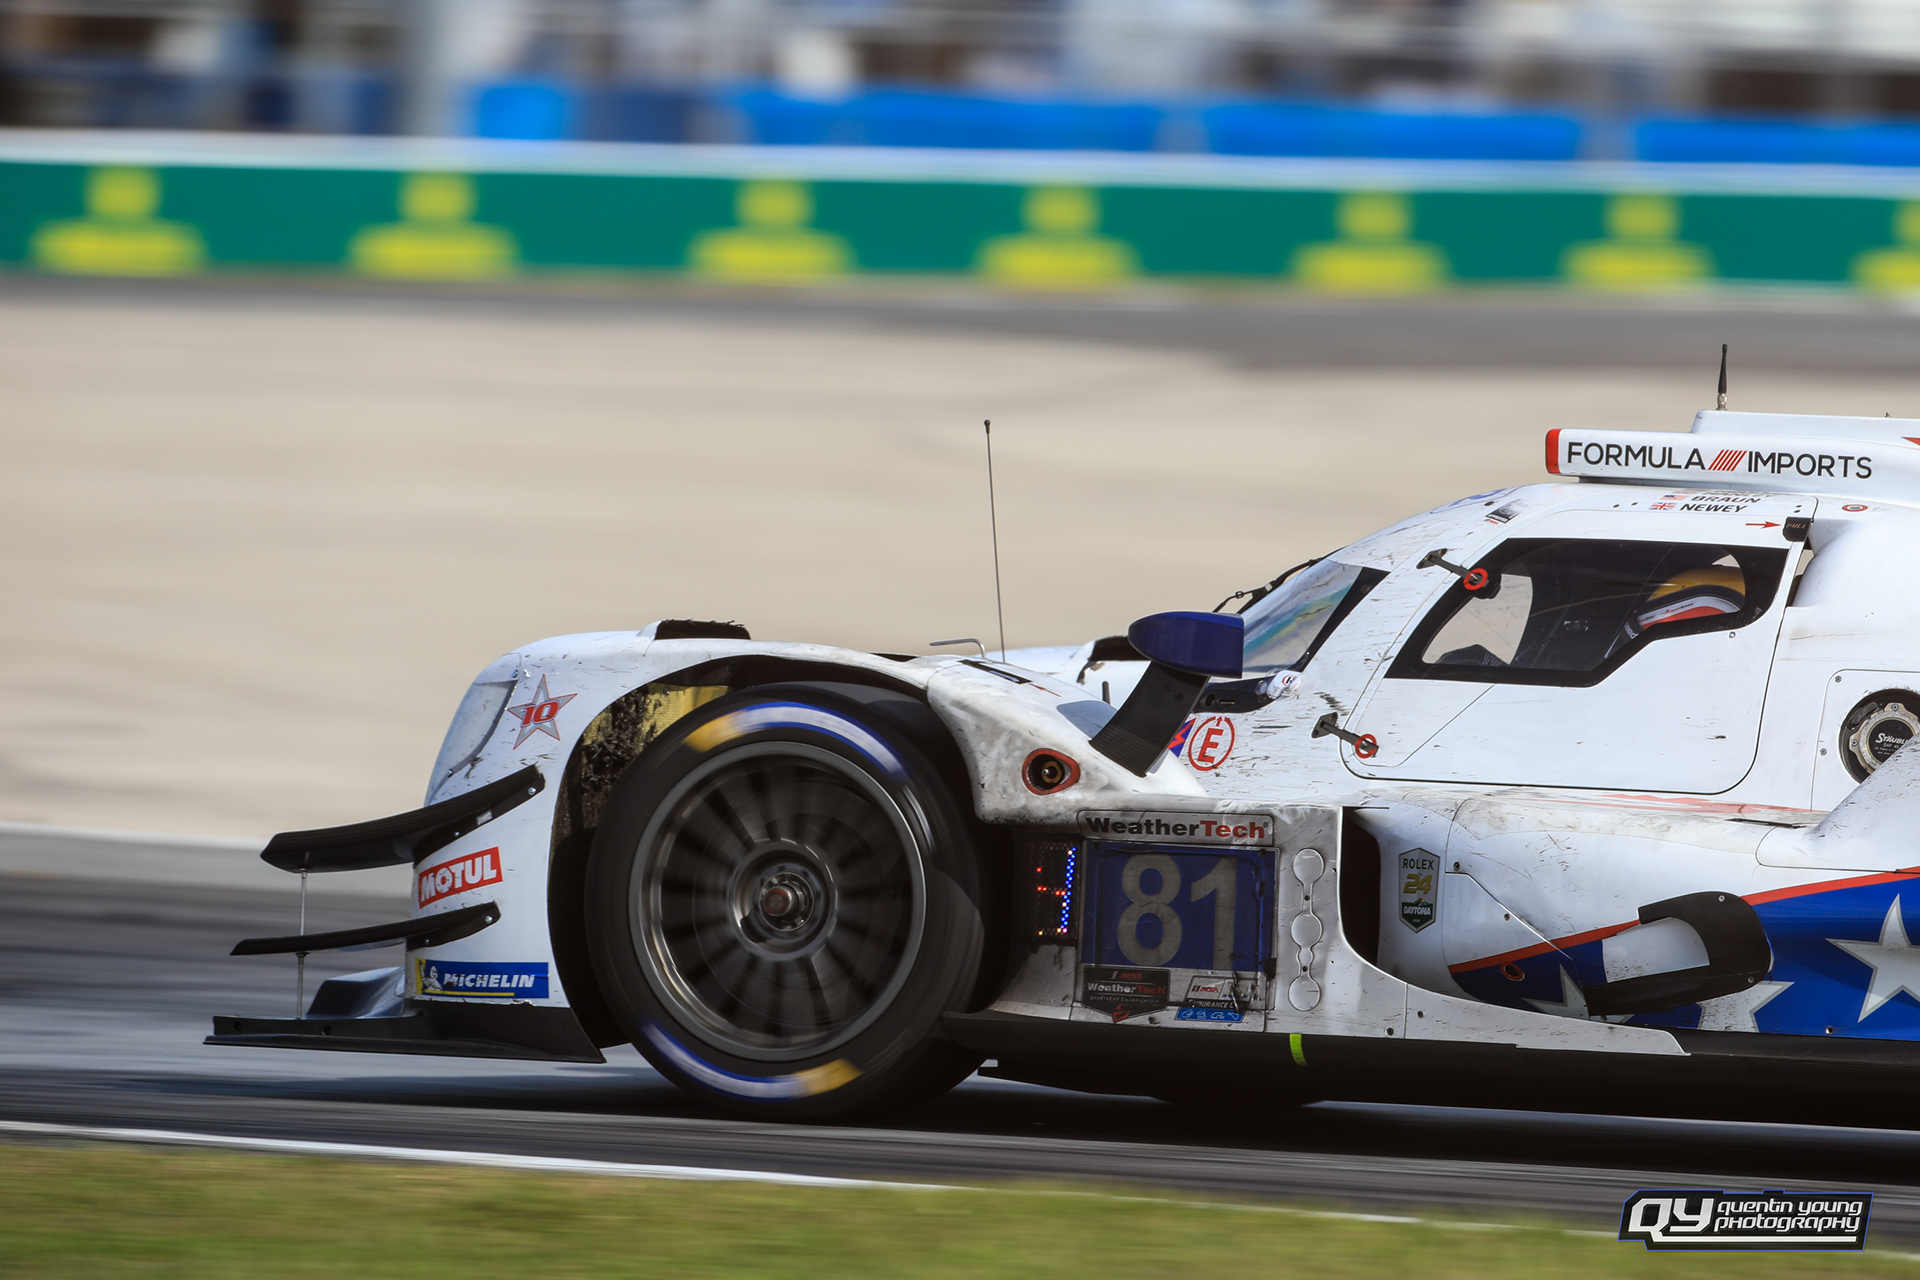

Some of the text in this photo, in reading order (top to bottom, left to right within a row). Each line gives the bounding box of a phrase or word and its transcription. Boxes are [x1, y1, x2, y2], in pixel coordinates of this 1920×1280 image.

[1567, 441, 1873, 480] FORMULA IMPORTS
[1679, 503, 1748, 513] NEWEY
[1690, 495, 1761, 504] BRAUN
[520, 700, 560, 728] 10
[1196, 727, 1224, 764] E
[1403, 858, 1434, 870] ROLEX
[420, 853, 498, 902] MOTUL
[1403, 873, 1432, 894] 24
[1117, 854, 1237, 970] 81
[1403, 906, 1431, 916] DAYTONA
[443, 972, 536, 989] MICHELIN
